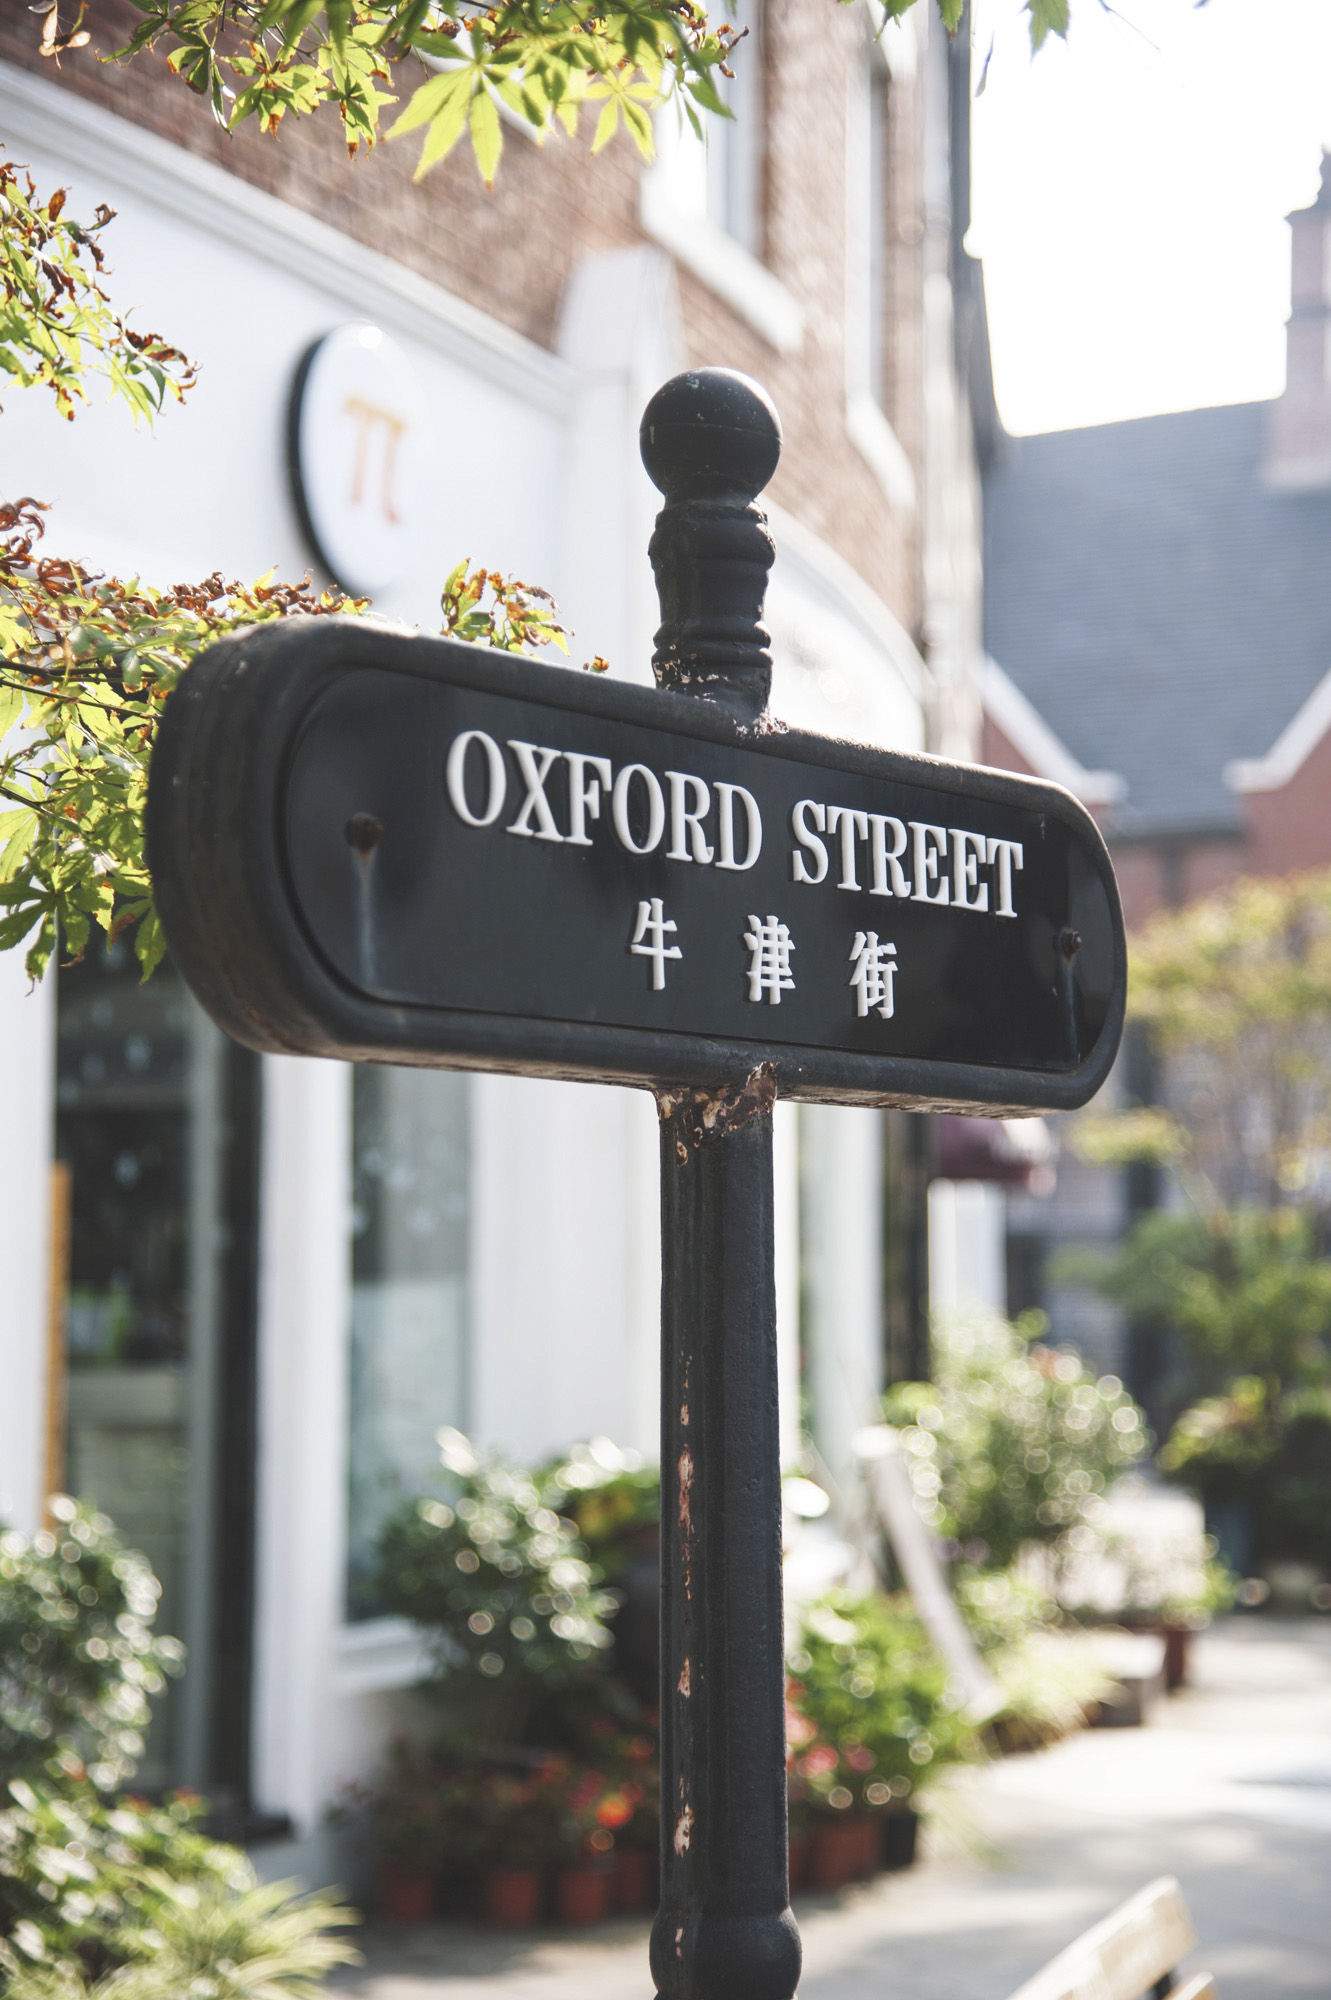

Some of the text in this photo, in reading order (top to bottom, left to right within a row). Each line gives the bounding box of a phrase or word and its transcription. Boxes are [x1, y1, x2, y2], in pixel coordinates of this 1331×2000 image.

[447, 730, 1023, 917] OXFORD STREET
[630, 897, 899, 1018] 牛津街
